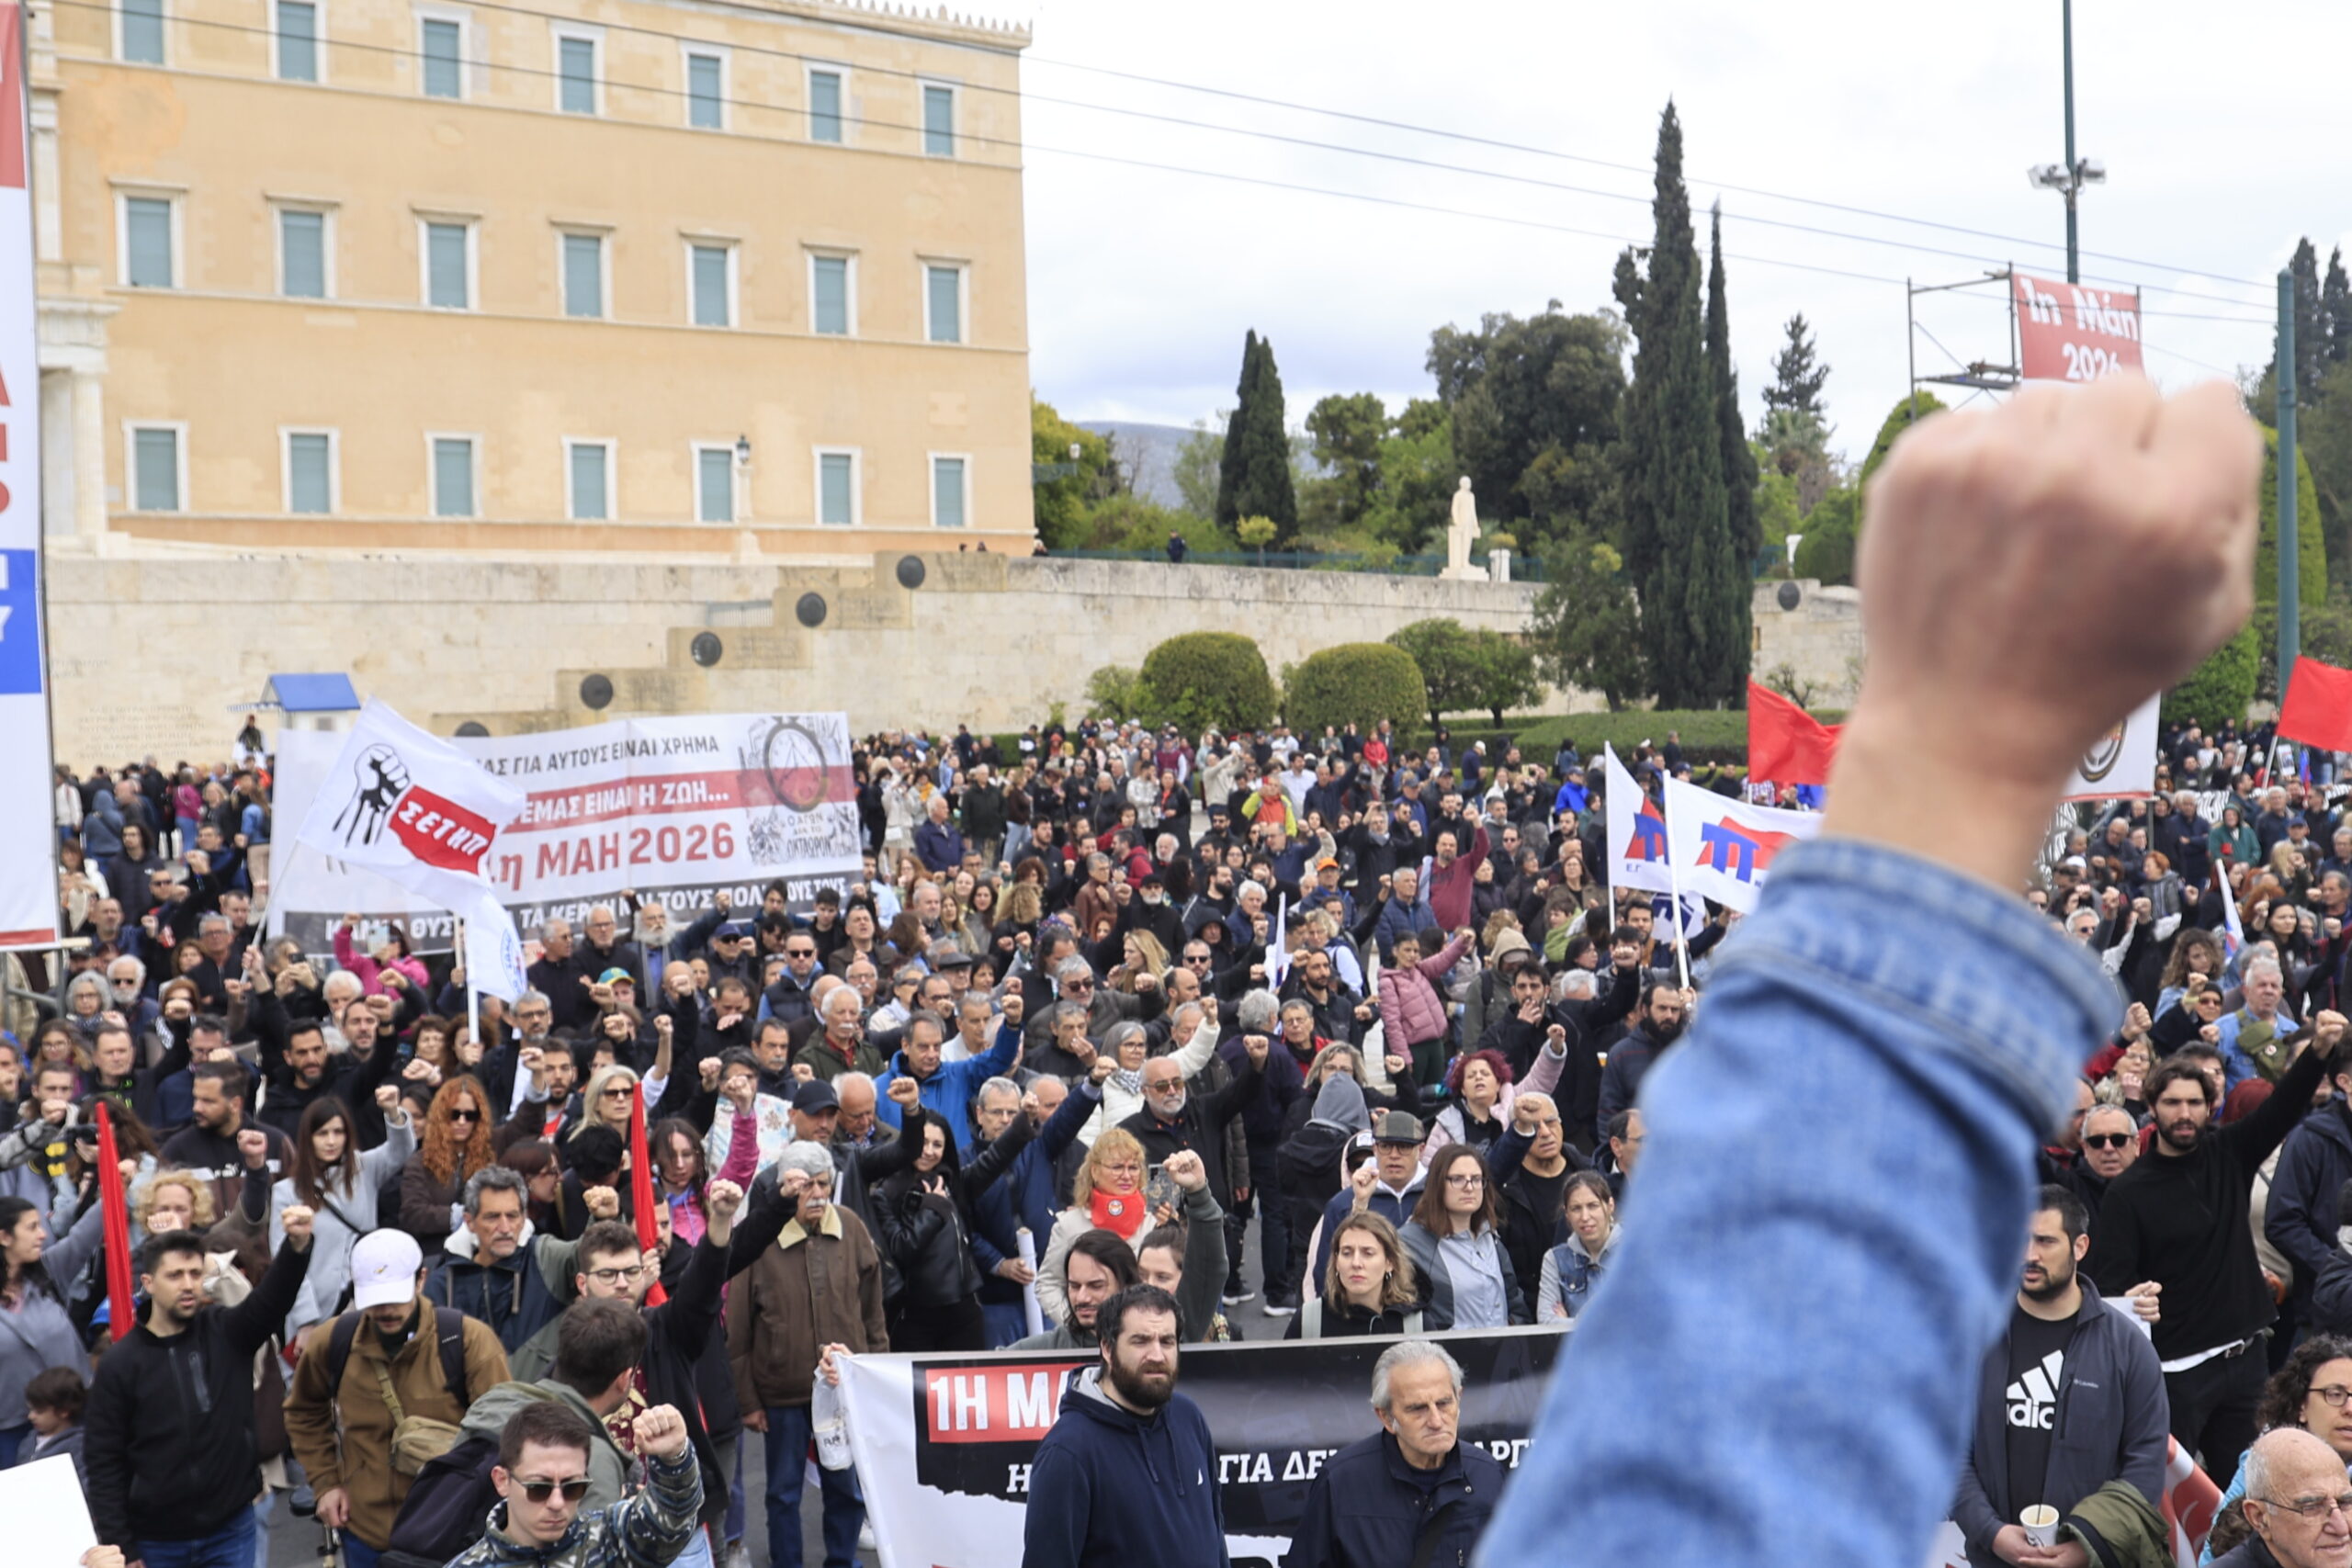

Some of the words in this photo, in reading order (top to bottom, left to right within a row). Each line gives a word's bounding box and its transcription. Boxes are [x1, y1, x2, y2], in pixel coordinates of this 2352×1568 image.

[477, 758, 507, 775] ΑΣ
[513, 755, 542, 774] ΓΙΑ
[548, 744, 608, 771] ΑΥΤΟΥΣ
[612, 739, 657, 761] ΕΙΝΑΙ
[662, 735, 719, 755] ΧΡΗΜΑ
[584, 784, 632, 816] ΕΙΝΑΙ
[639, 784, 656, 807] Η
[536, 831, 620, 880] ΜΑΗ
[628, 822, 735, 865] 2026
[1282, 1449, 1338, 1482] ΔΕ
